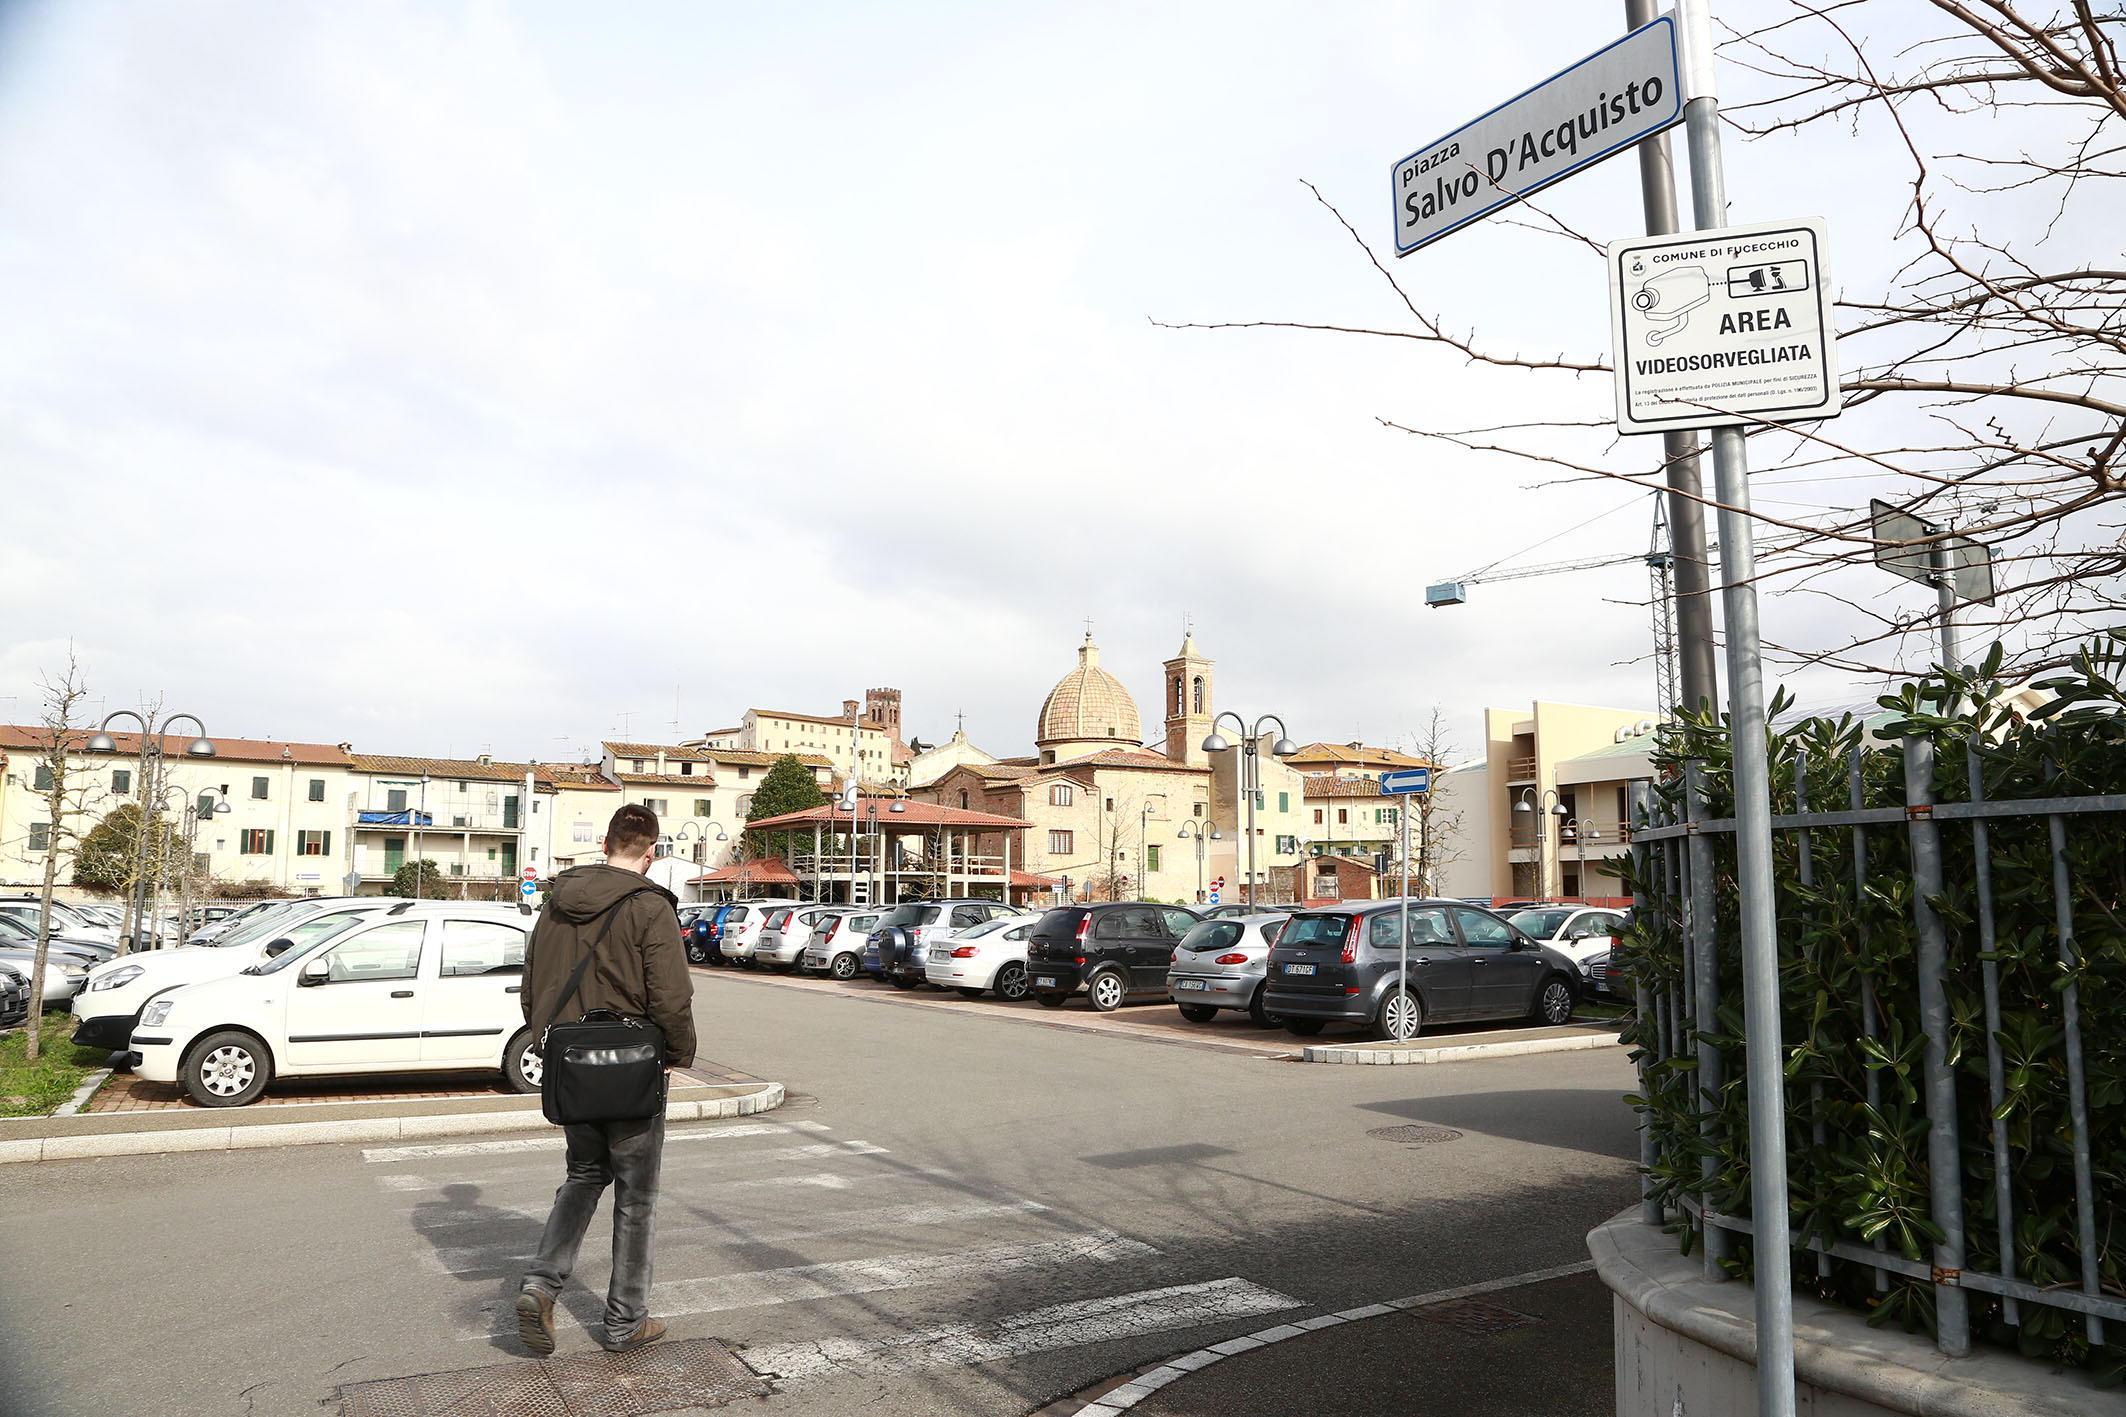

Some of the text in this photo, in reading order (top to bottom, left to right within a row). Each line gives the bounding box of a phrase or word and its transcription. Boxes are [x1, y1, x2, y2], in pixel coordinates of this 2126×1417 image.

[1402, 142, 1460, 187] piazza
[1406, 76, 1663, 227] Salvo D'Acquisto
[1652, 239, 1799, 263] COMUNE DI FUCECCHIO
[1719, 307, 1792, 335] AREA
[1636, 344, 1812, 375] VIDEOSORVEGLIATA
[1642, 387, 1674, 395] registrazione
[1732, 378, 1762, 386] MUNICIPALE
[1789, 373, 1818, 381] SICUREZZA
